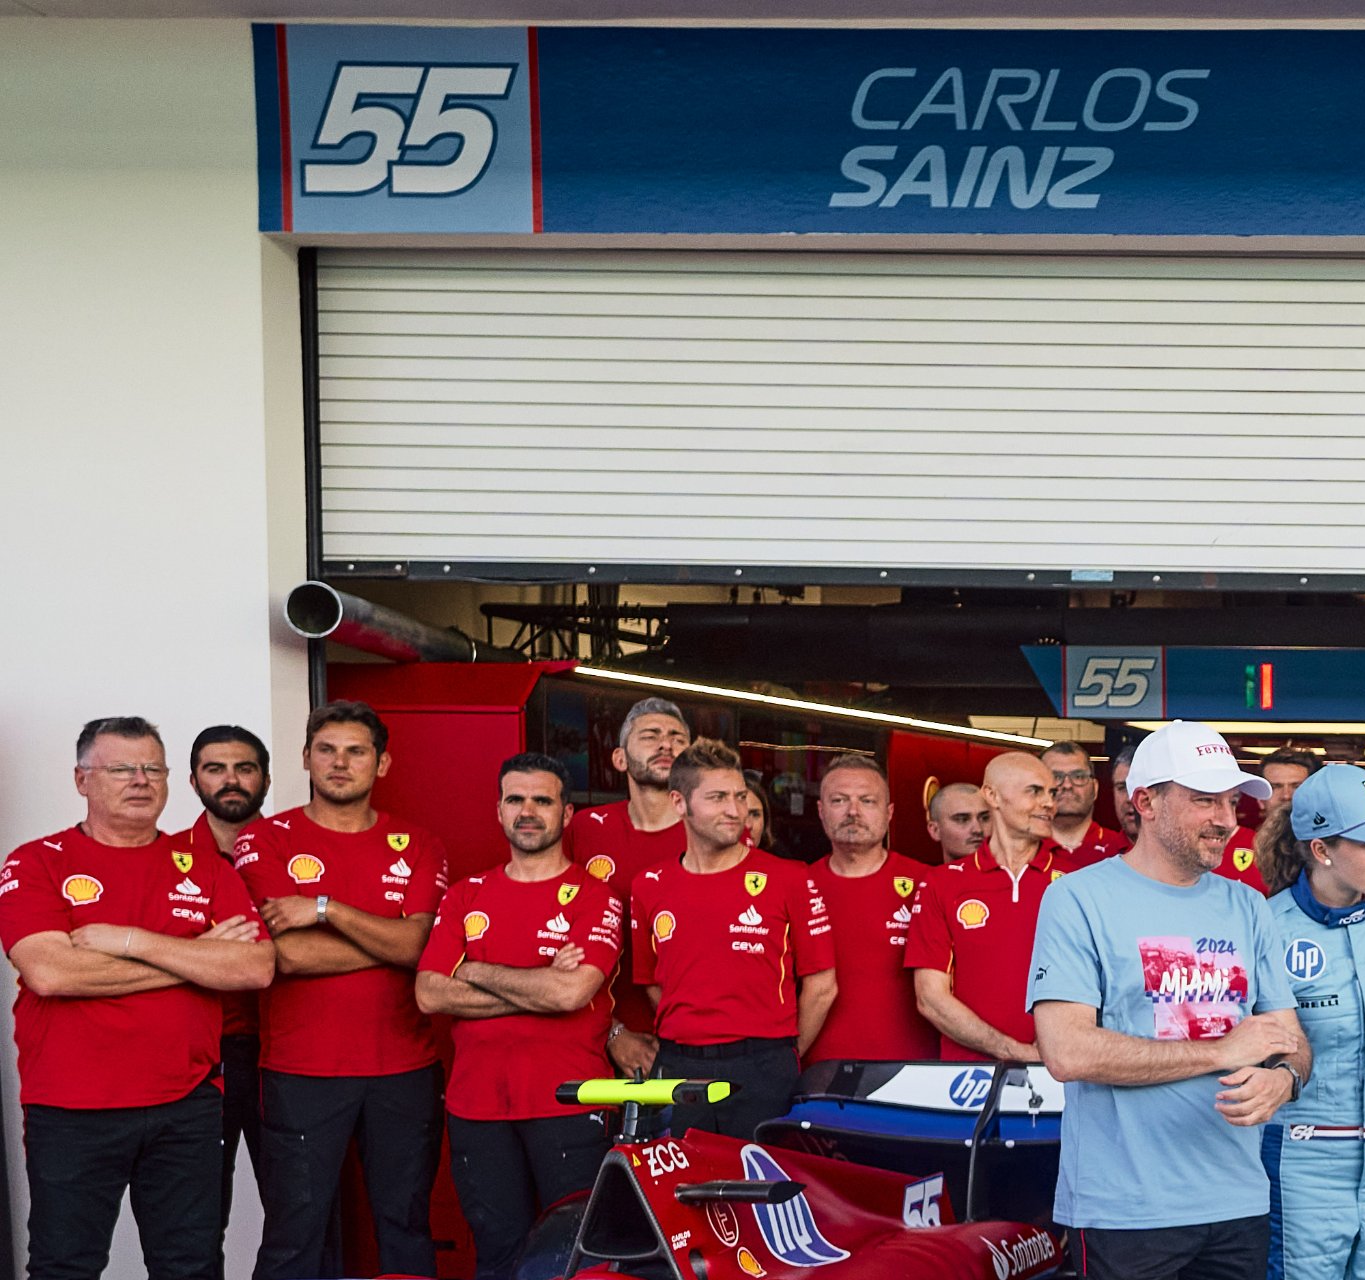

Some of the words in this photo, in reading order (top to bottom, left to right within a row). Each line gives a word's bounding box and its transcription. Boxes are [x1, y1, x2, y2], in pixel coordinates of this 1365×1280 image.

[851, 67, 1209, 132] CARLOS
[302, 62, 518, 197] 55
[829, 146, 1114, 209] SAINZ
[1072, 656, 1157, 708] 55
[1195, 937, 1237, 956] 2024
[1289, 938, 1321, 981] hp
[953, 1068, 993, 1109] hp
[1290, 1124, 1316, 1140] 64
